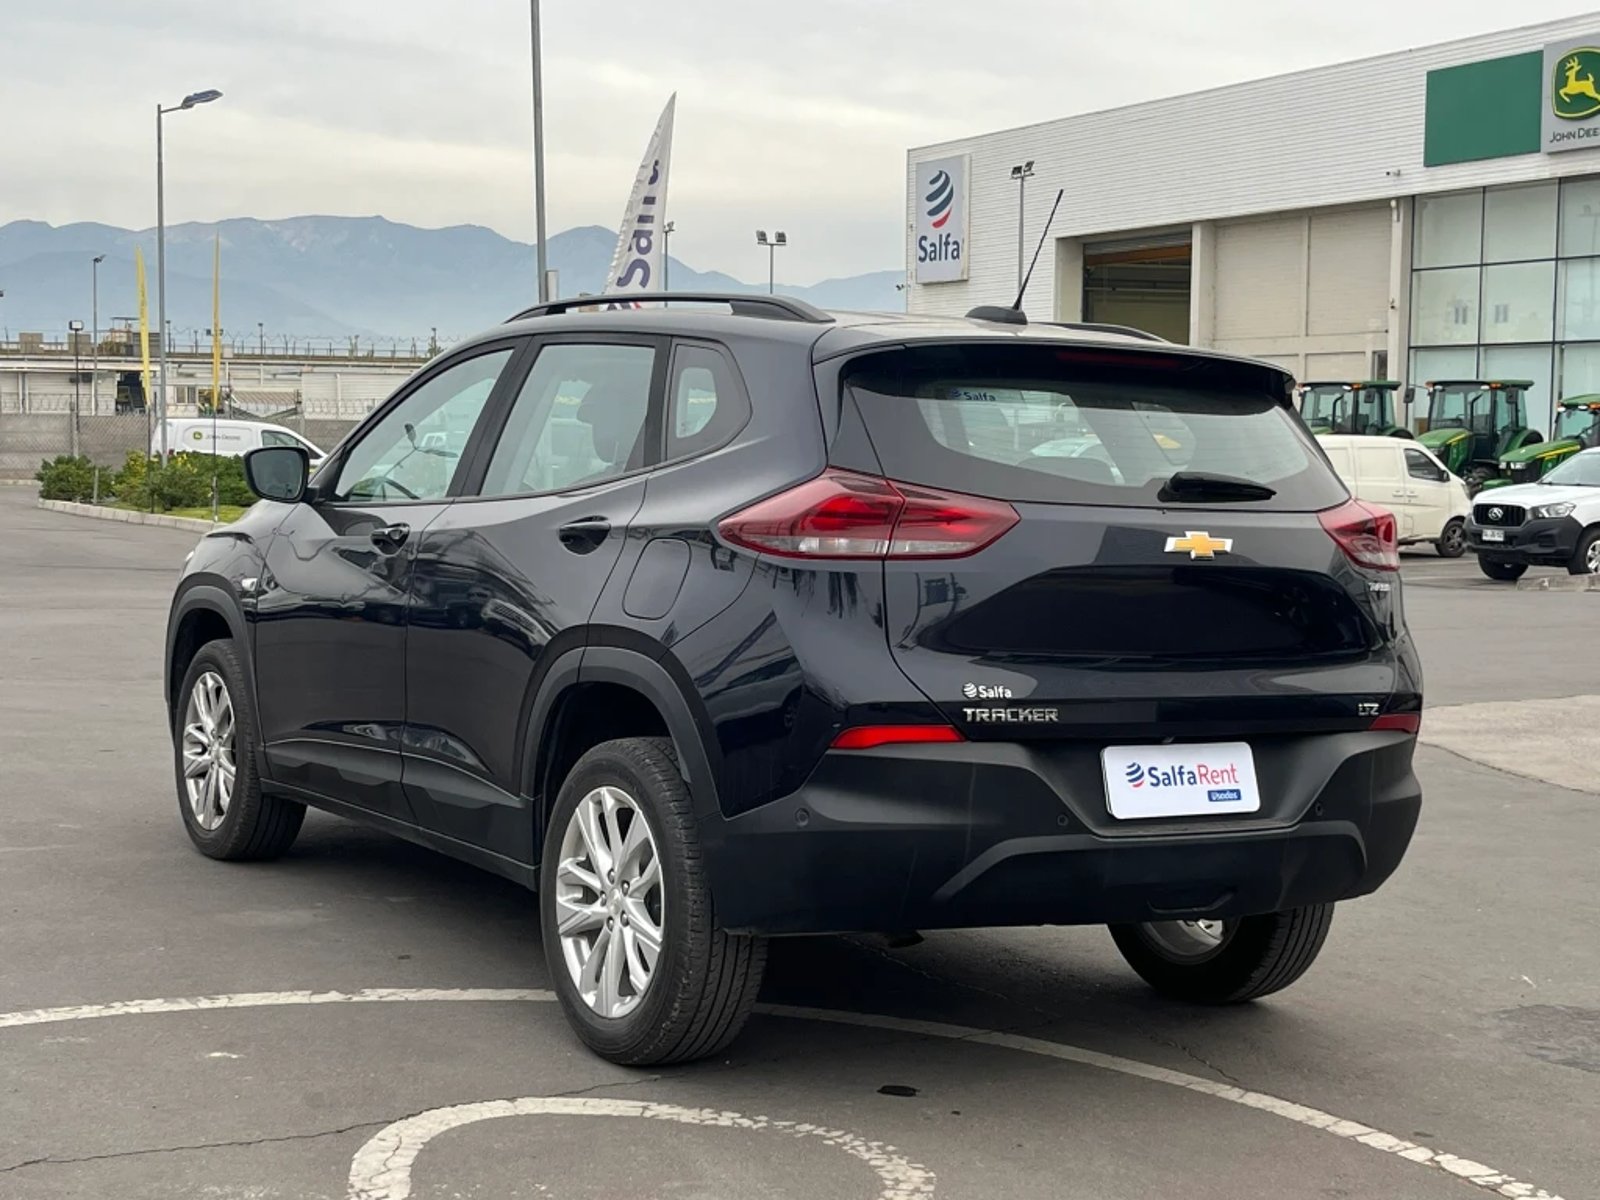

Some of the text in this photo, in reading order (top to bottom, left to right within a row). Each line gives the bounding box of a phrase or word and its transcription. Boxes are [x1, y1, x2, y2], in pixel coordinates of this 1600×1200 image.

[1549, 131, 1576, 143] JOHN
[918, 233, 960, 263] Salfa
[978, 685, 1012, 699] Salfa
[963, 708, 1059, 722] TRACKER
[1358, 703, 1379, 716] LTZ
[1148, 763, 1239, 787] SalfaRent
